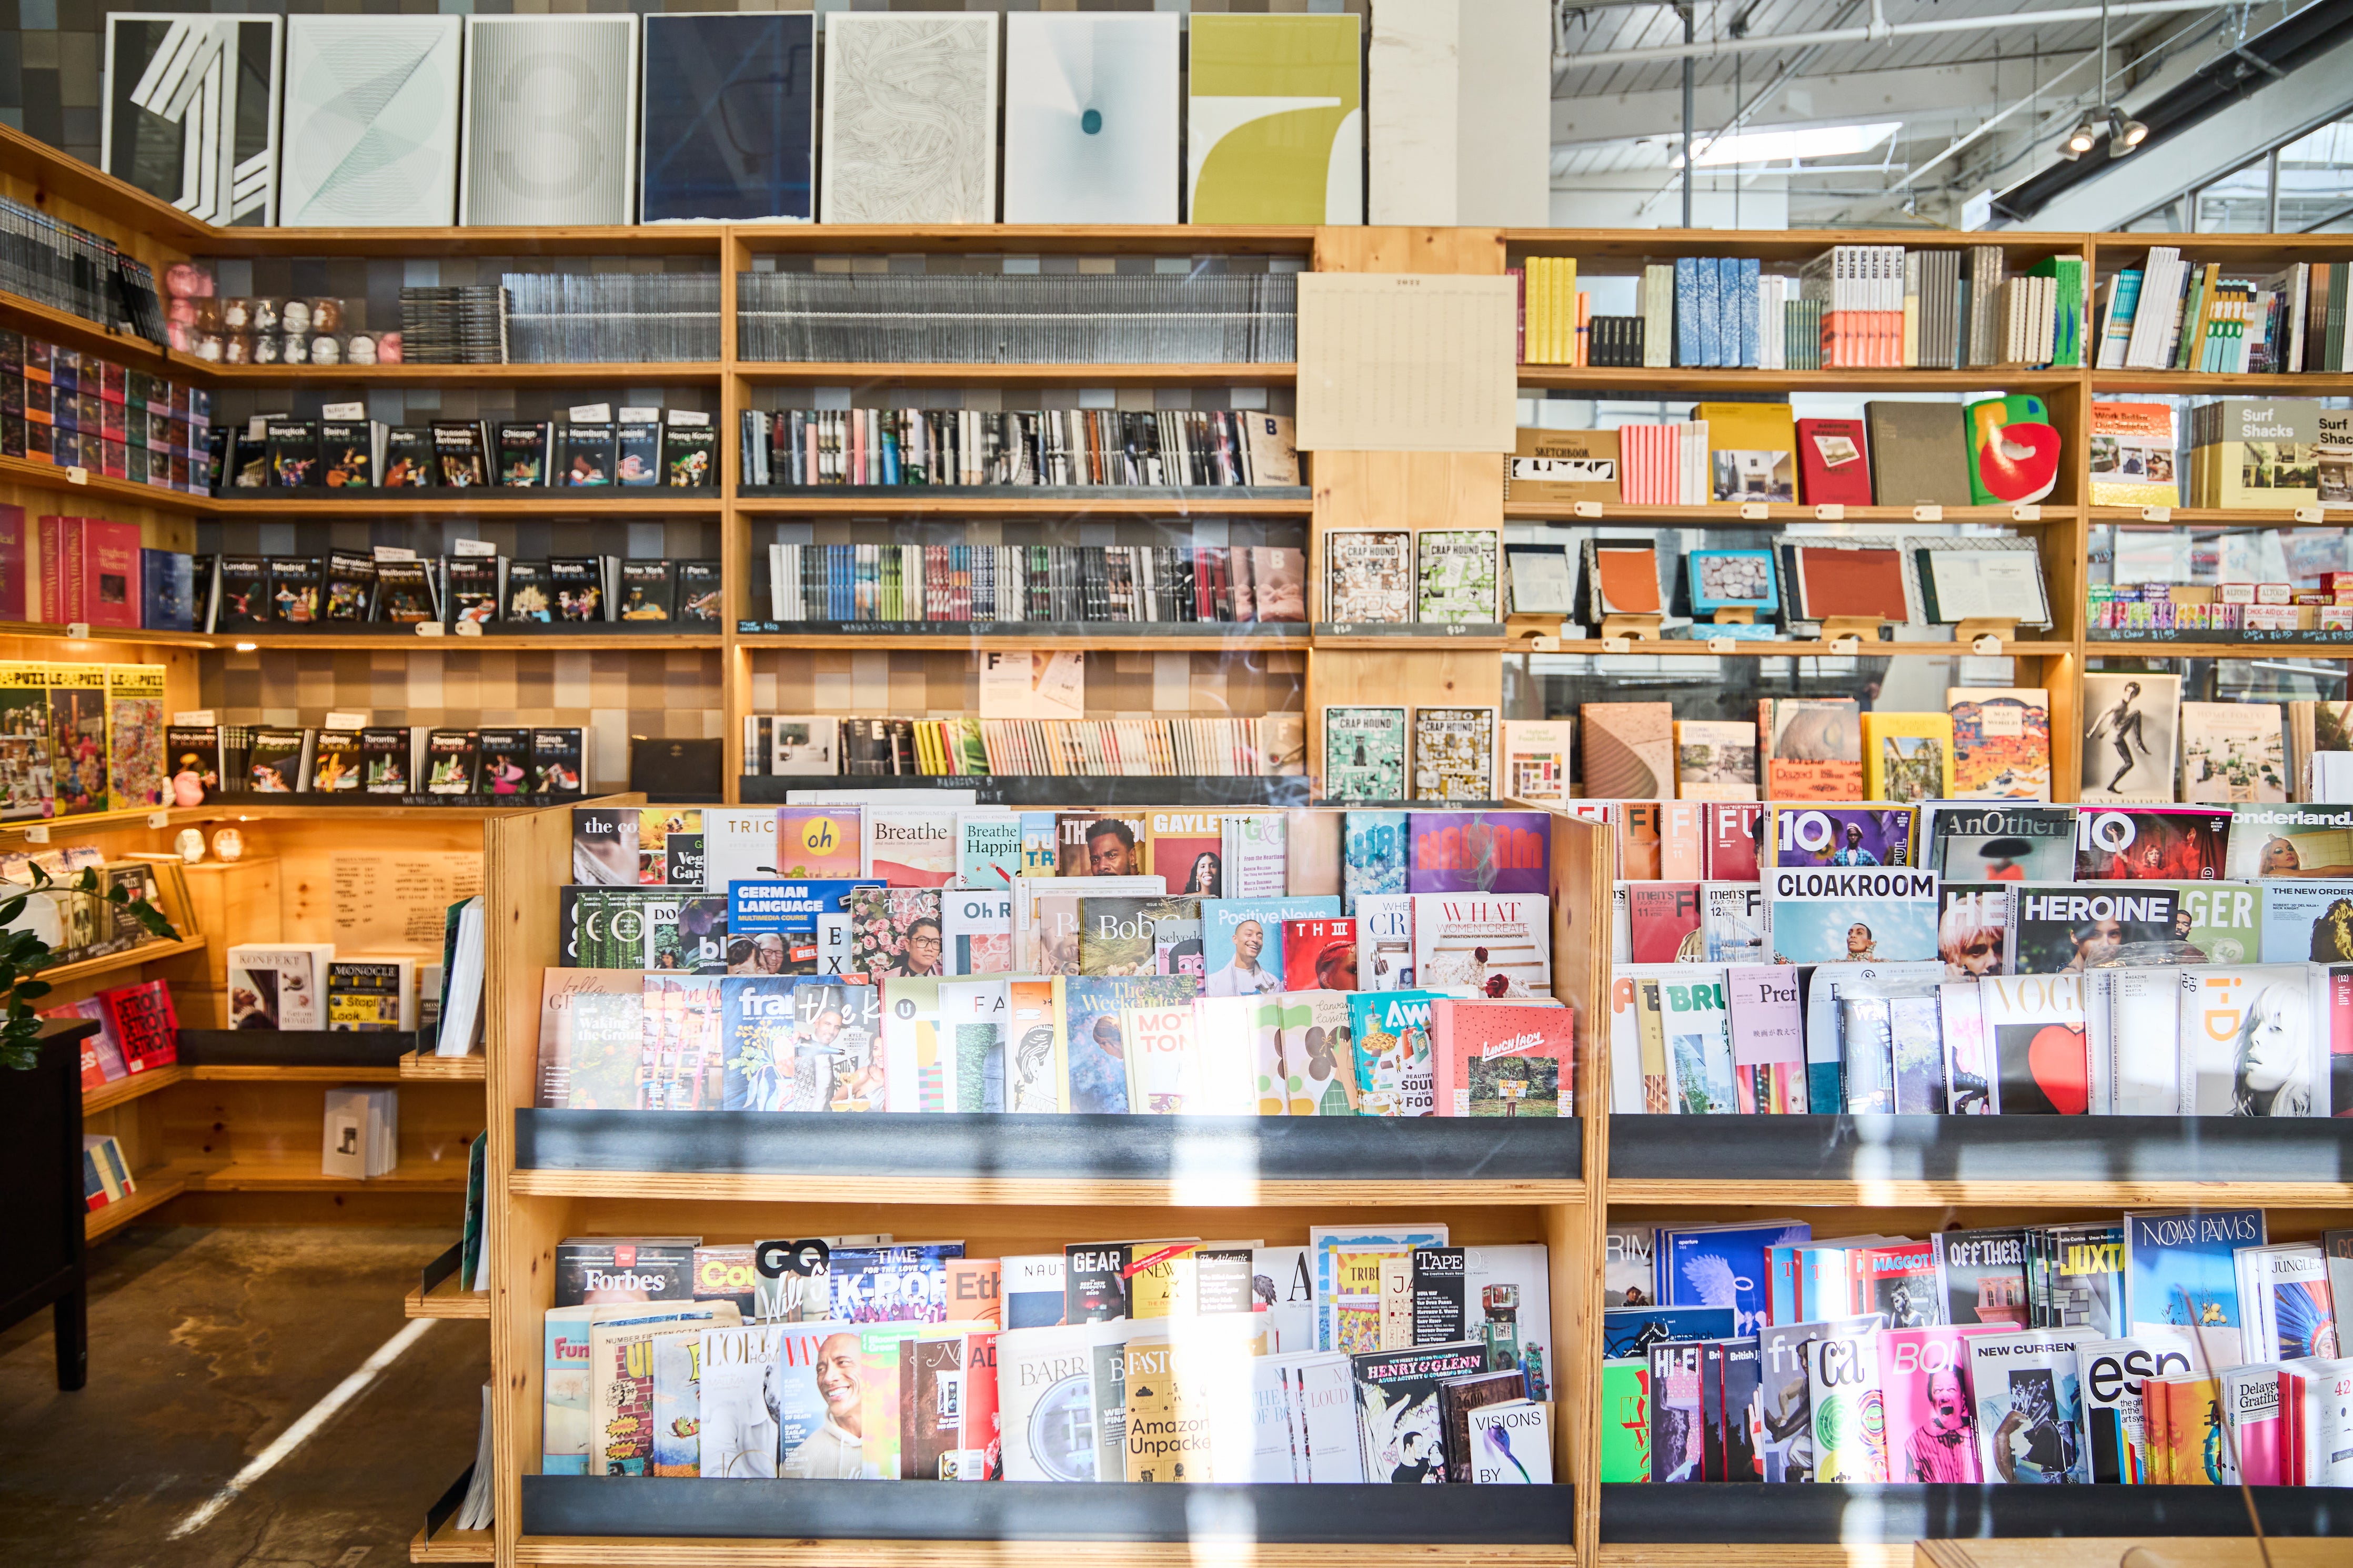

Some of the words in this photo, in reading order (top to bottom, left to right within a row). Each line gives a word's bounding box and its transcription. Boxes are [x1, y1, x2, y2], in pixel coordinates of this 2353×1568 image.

[2243, 409, 2274, 421] Surf
[2242, 424, 2294, 437] Shacks
[2319, 419, 2347, 430] Surf
[269, 427, 306, 436] Bangkok
[502, 429, 537, 438] Chicago
[569, 429, 610, 439] Hamburg
[668, 431, 690, 441] Hong
[692, 432, 713, 441] Kong
[1535, 448, 1590, 457] SKETCHBOOK
[1348, 547, 1369, 556] CRAP
[1370, 547, 1395, 556] HOUND
[1432, 546, 1451, 555] CRAP
[1453, 545, 1479, 554] HOUND
[223, 562, 258, 571] London
[272, 563, 306, 572] Madrid
[551, 564, 584, 573] Munich
[49, 674, 62, 684] LE
[79, 674, 104, 685] PUZZ
[112, 675, 123, 685] LE
[139, 675, 163, 685] PUZZ
[1340, 719, 1366, 729] CRAP
[1367, 718, 1392, 729] HOUND
[1425, 722, 1445, 732] CRAP
[1446, 721, 1473, 732] HOUND
[257, 735, 300, 746] Singapore
[319, 735, 350, 745] Sydney
[433, 737, 466, 745] Toronto
[1942, 811, 2060, 836] AnOther
[808, 821, 831, 848] oh
[875, 822, 947, 839] Breathe
[968, 824, 1017, 837] Breathe
[1778, 811, 1832, 852] 10
[2078, 812, 2136, 852] 10
[1777, 874, 1933, 897] CLOAKROOM
[738, 886, 808, 898] GERMAN
[1637, 890, 1674, 900] men's
[1710, 889, 1745, 899] men's
[738, 901, 823, 913] LANGUAGE
[963, 902, 993, 918] Oh
[1442, 902, 1521, 923] WHAT
[2025, 895, 2170, 923] HEROINE
[1099, 911, 1155, 940] Bob
[1436, 923, 1485, 933] WOMEN
[1487, 923, 1529, 933] CREATE
[334, 965, 396, 977] MONOCLE
[1110, 982, 1145, 999] The
[2205, 977, 2242, 1041] i-D
[579, 1017, 630, 1028] Waking
[1482, 1038, 1515, 1062] LUNCH
[1514, 1031, 1545, 1051] LADY
[877, 1249, 917, 1265] TIME
[1073, 1251, 1120, 1273] GEAR
[1199, 1254, 1215, 1263] The
[1217, 1253, 1248, 1262] Atlantic
[1416, 1252, 1463, 1270] TAPE
[2271, 1258, 2316, 1273] JUNGLE
[585, 1269, 666, 1292] Forbes
[1668, 1330, 1714, 1341] borshch
[1730, 1350, 1754, 1361] British
[1978, 1348, 2010, 1357] NEW
[1367, 1362, 1419, 1380] HENRY
[1431, 1355, 1481, 1370] GLENN
[1311, 1389, 1348, 1408] LOUD
[1475, 1411, 1541, 1431] VISIONS
[1480, 1469, 1501, 1483] BY
